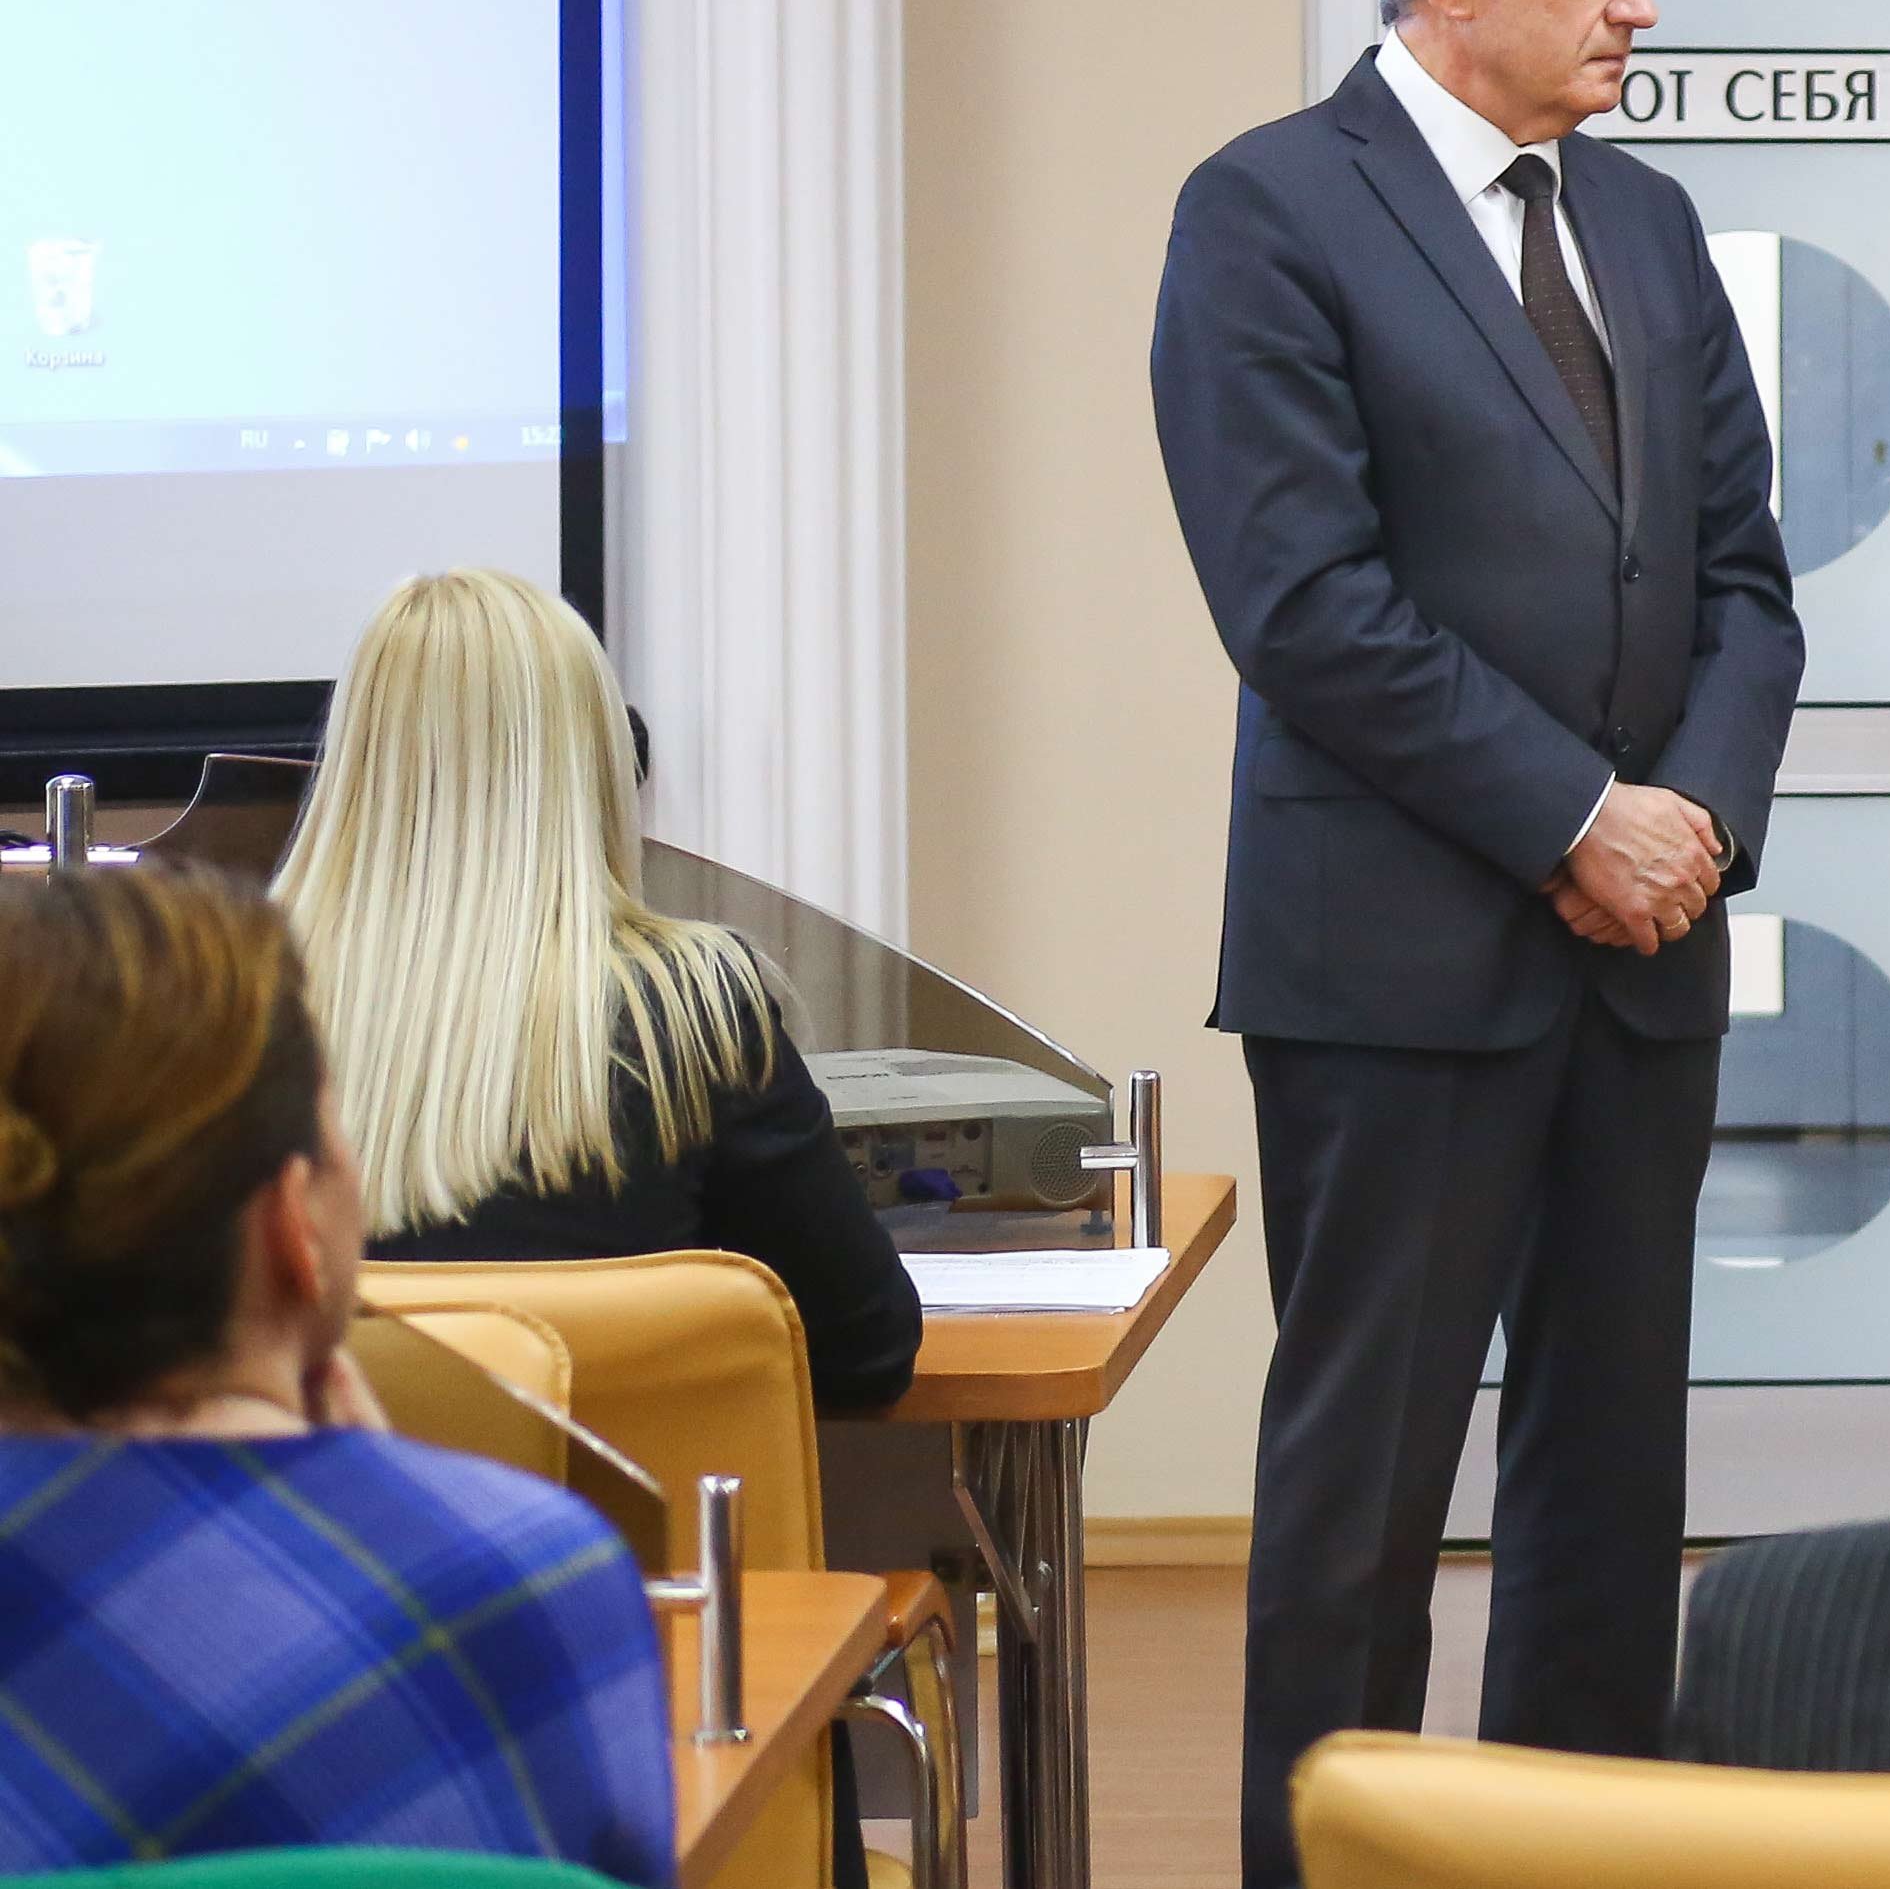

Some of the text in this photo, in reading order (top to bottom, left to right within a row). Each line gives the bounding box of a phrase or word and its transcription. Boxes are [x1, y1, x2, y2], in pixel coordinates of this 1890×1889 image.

[1620, 69, 1879, 123] ОТ СЕБЯ
[241, 429, 268, 448] RU
